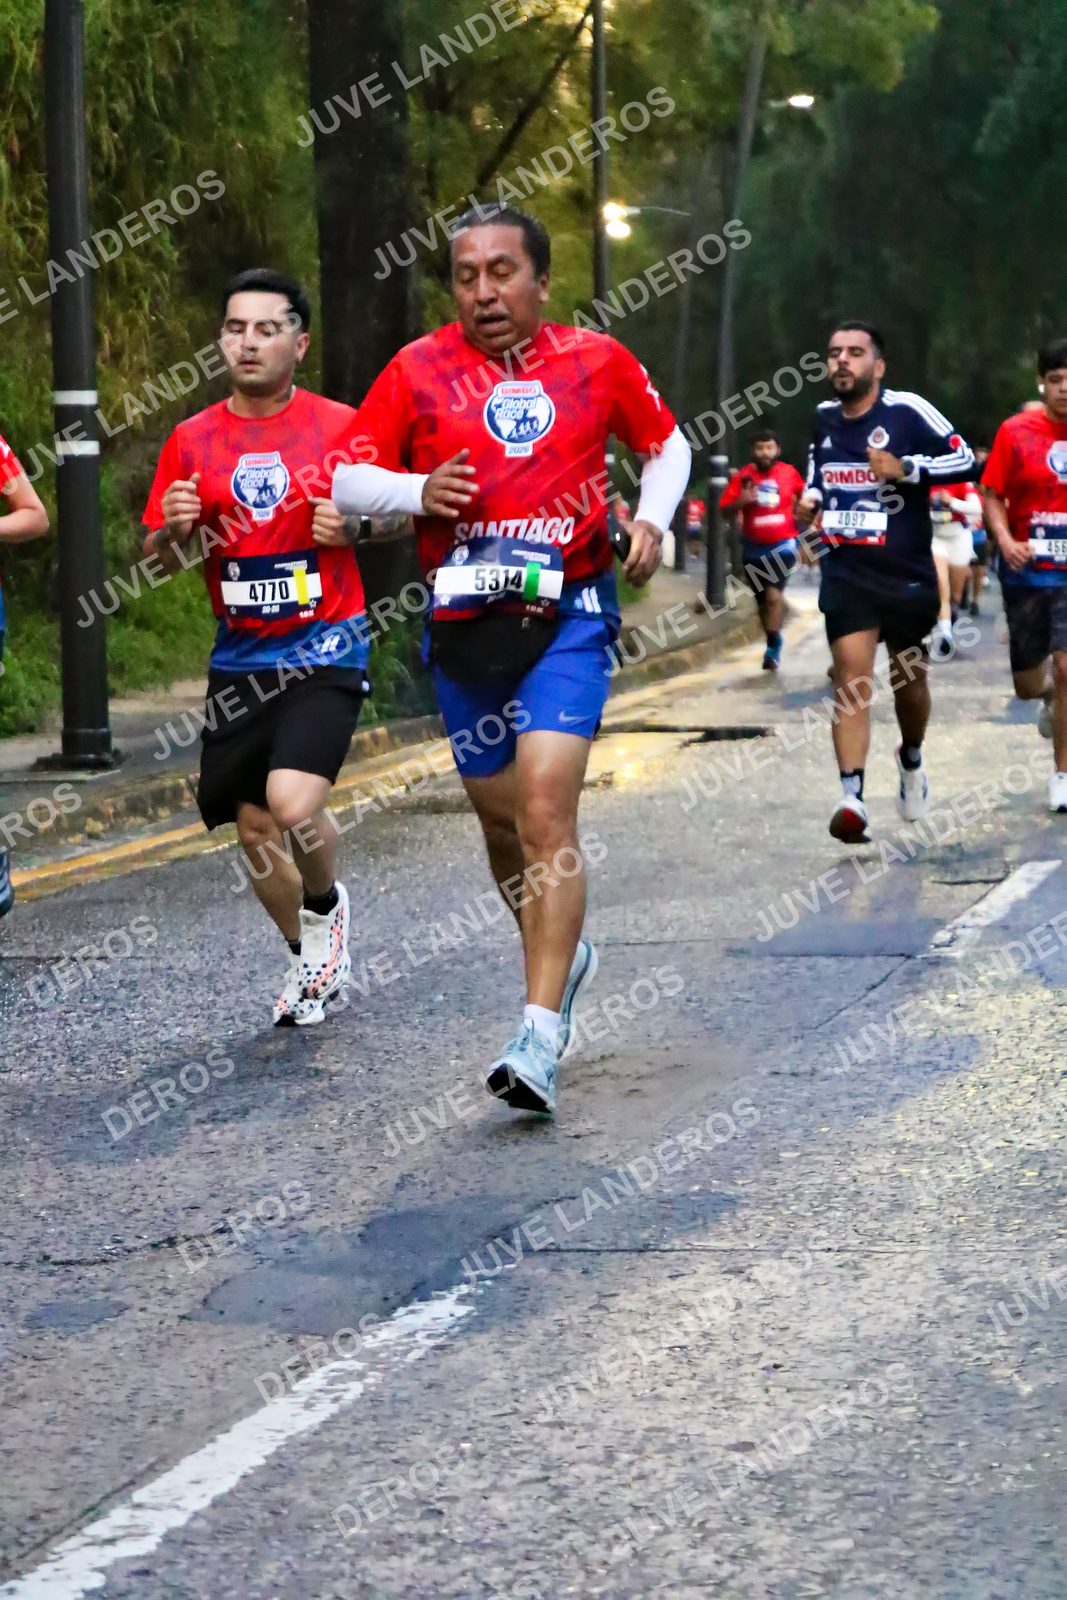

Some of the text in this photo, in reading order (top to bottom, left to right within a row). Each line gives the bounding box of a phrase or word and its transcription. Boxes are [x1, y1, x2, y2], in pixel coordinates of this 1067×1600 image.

[454, 516, 575, 545] SANTIAGO
[838, 512, 866, 527] 4092
[474, 567, 523, 592] 5314
[249, 580, 290, 603] 4770
[299, 609, 315, 619] 10K
